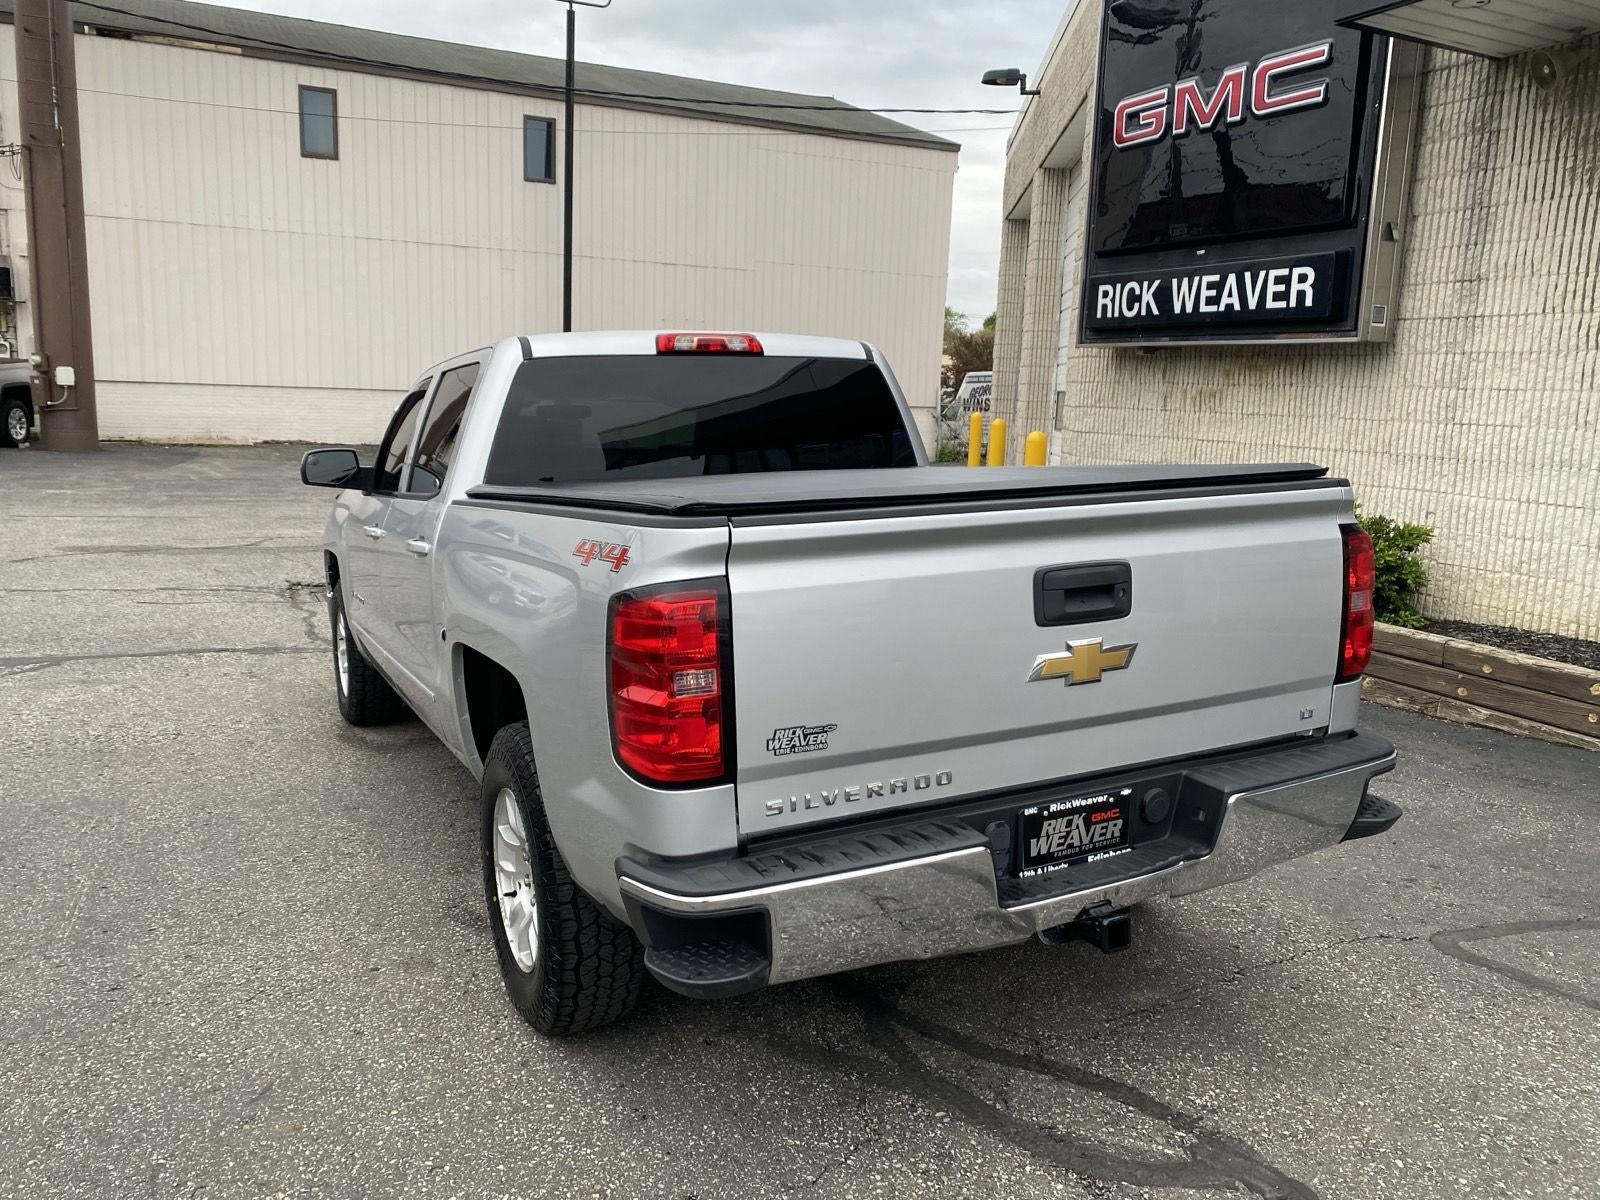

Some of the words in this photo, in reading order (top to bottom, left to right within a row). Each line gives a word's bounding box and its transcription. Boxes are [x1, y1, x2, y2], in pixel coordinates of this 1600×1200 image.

[1113, 41, 1334, 148] GMC
[1096, 279, 1161, 319] RICK
[1171, 266, 1316, 314] WEAVER
[767, 733, 828, 750] WEAVER
[774, 726, 806, 739] RICK
[765, 770, 953, 817] SILVERADO
[1030, 819, 1123, 856] WEAVER
[1041, 813, 1087, 838] RICK
[1091, 808, 1120, 822] GMC
[1054, 848, 1079, 858] FAMOUS
[1095, 837, 1121, 848] SERVICE
